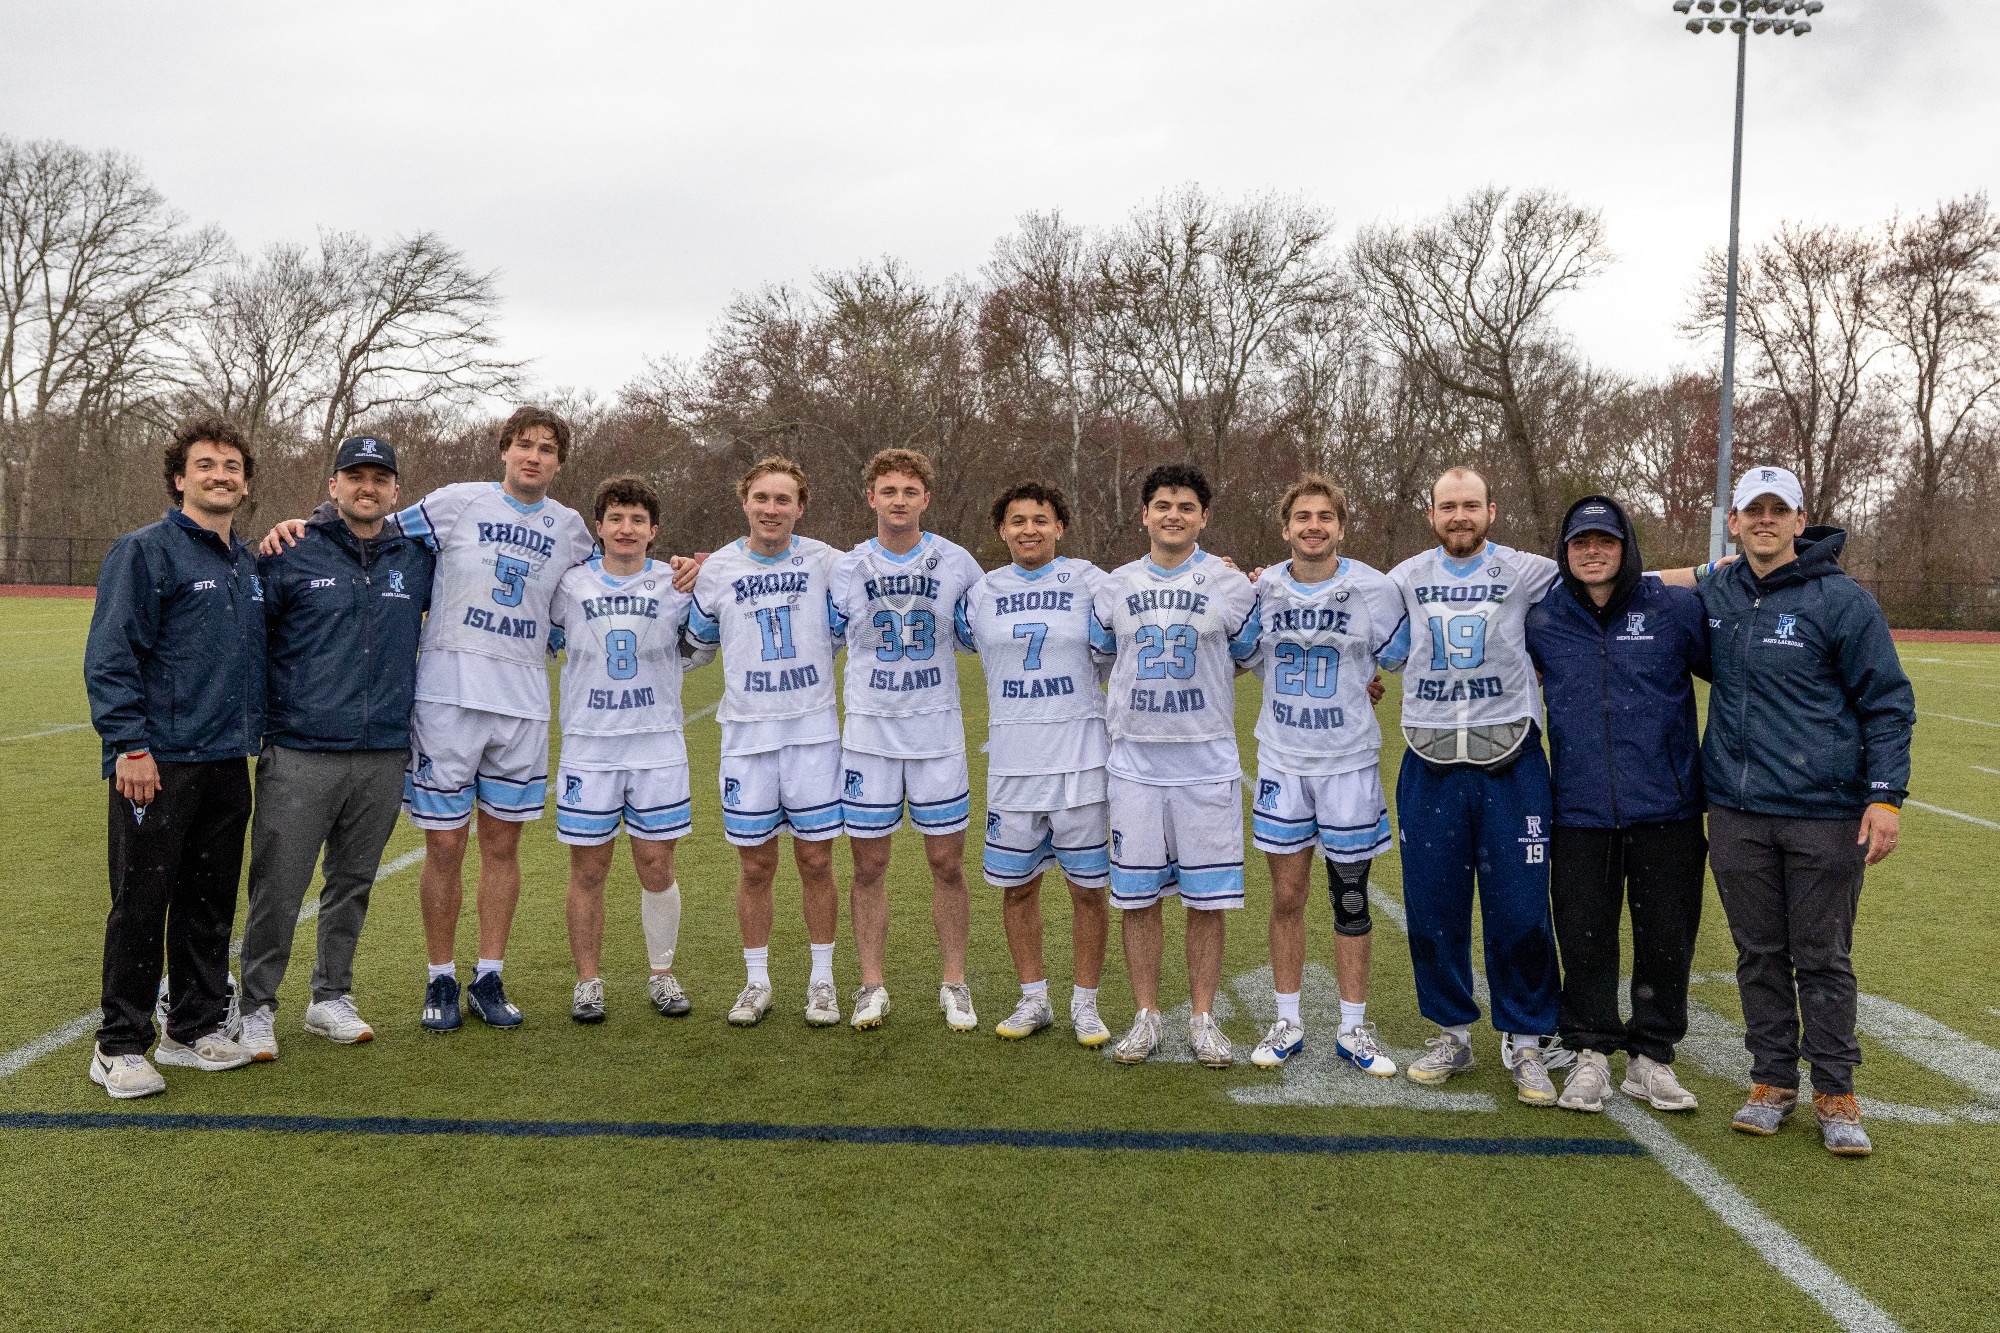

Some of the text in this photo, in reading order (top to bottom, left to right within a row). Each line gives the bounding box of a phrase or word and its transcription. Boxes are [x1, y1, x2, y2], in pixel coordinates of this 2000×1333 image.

[477, 522, 556, 558] RHODE
[194, 580, 217, 591] STX
[310, 578, 336, 588] STX
[492, 553, 530, 608] 5
[731, 571, 810, 602] RHODE
[864, 574, 941, 601] RHODE
[581, 595, 660, 620] RHODE
[995, 590, 1074, 616] RHODE
[1126, 589, 1209, 616] RHODE
[1414, 584, 1508, 605] RHODE
[463, 606, 537, 639] ISLAND
[755, 605, 797, 662] 11
[1271, 608, 1352, 634] RHODE
[873, 609, 936, 662] 33
[1013, 622, 1048, 671] 7
[1428, 614, 1488, 671] 19
[605, 629, 638, 680] 8
[1135, 623, 1198, 680] 23
[744, 664, 820, 692] ISLAND
[869, 666, 942, 692] ISLAND
[1275, 642, 1341, 699] 20
[587, 686, 655, 710] ISLAND
[1002, 675, 1075, 698] ISLAND
[1416, 676, 1504, 701] ISLAND
[1130, 688, 1206, 713] ISLAND
[1870, 781, 1889, 789] STX
[1525, 843, 1544, 864] 19
